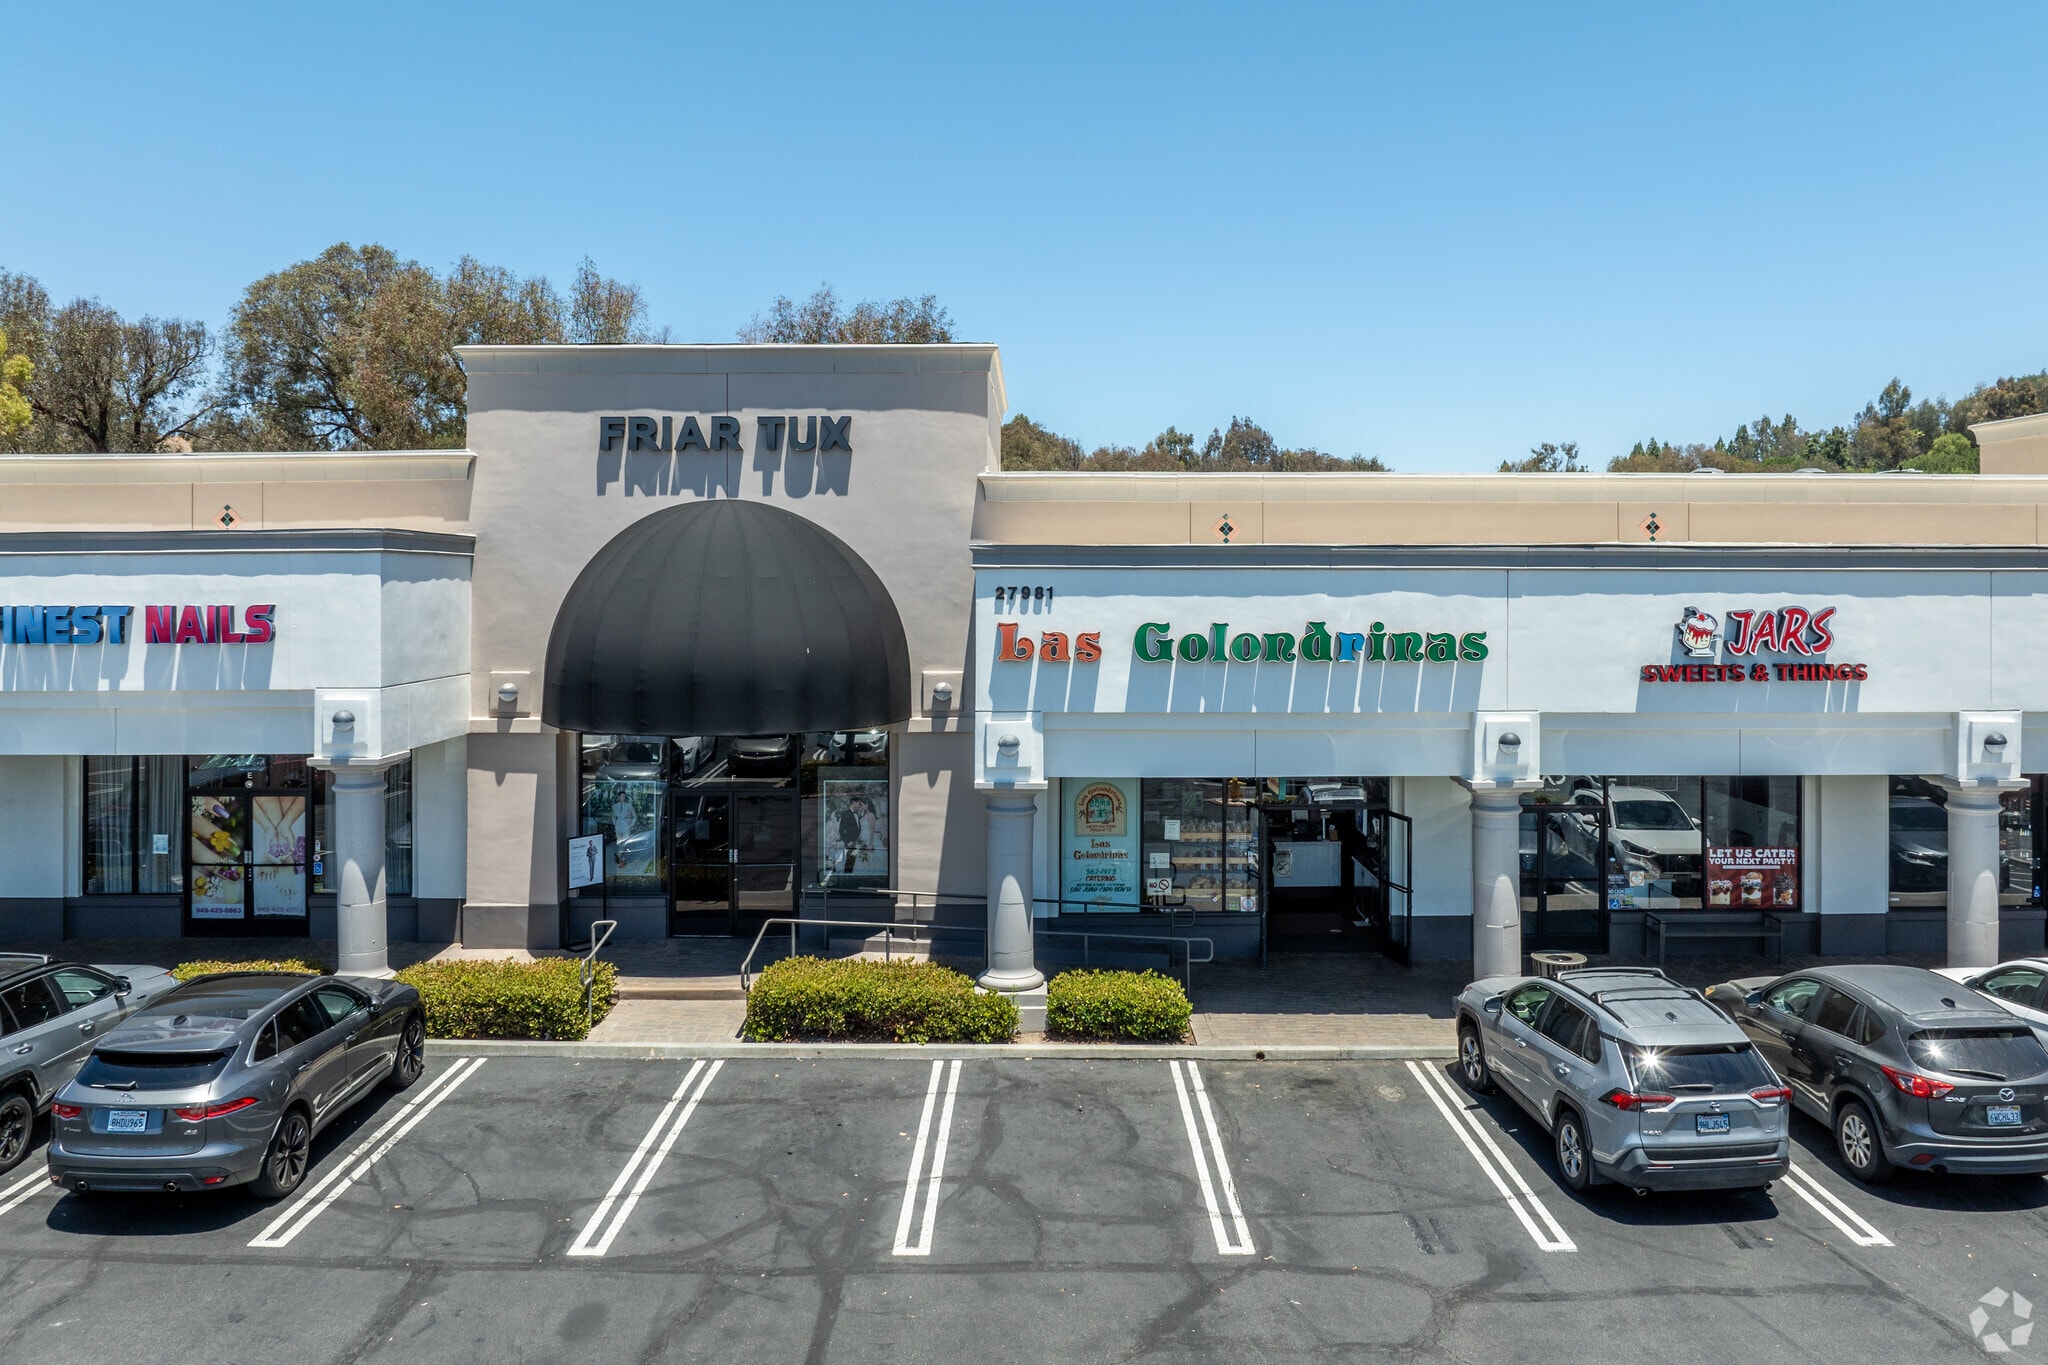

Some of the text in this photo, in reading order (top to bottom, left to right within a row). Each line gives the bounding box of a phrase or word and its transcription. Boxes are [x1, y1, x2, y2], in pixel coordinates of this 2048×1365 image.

[599, 415, 853, 451] FRIAR TUX
[995, 586, 1054, 600] 27981
[0, 604, 276, 645] INEST NAILS
[1724, 606, 1837, 657] JARS
[997, 620, 1489, 664] Las Golondrinas
[1640, 663, 1869, 683] SWEETS & THINGS
[1091, 838, 1111, 848] Las
[1073, 850, 1129, 861] Golondrinas
[1708, 857, 1796, 865] YOUR NEXT PARTY!
[1709, 848, 1796, 858] LET US CATER
